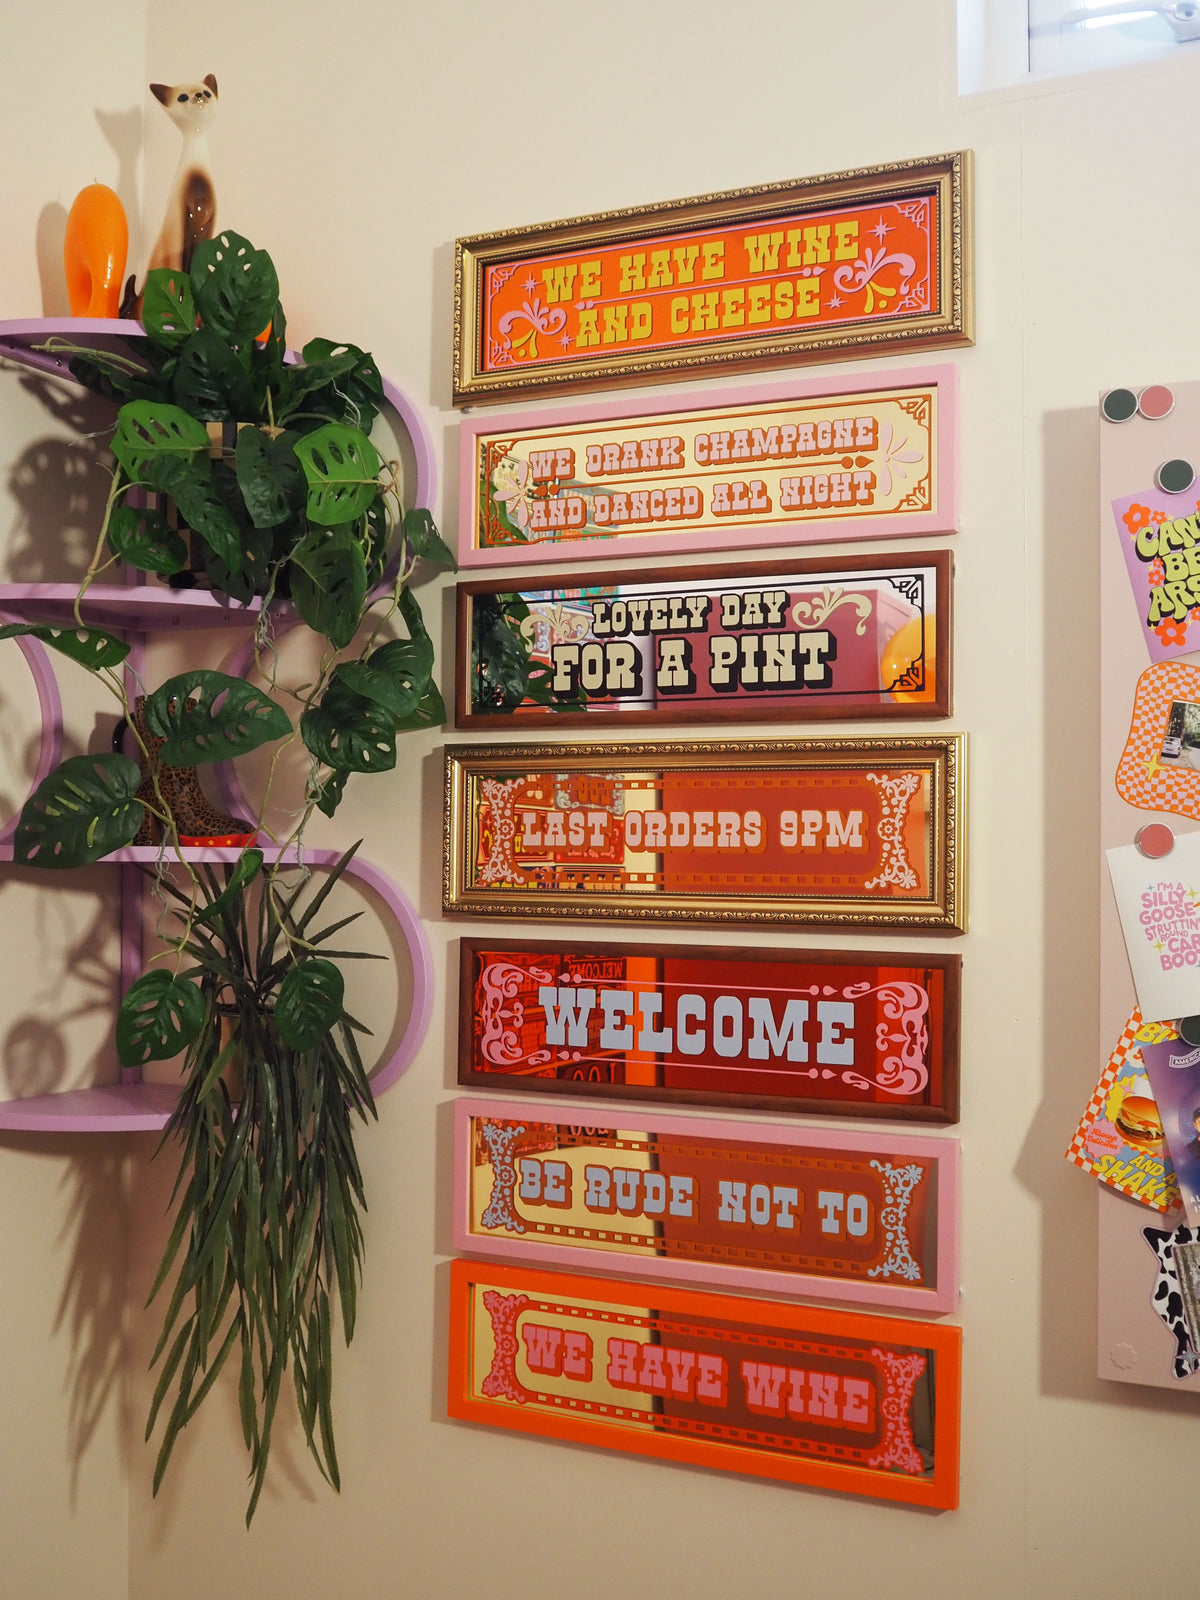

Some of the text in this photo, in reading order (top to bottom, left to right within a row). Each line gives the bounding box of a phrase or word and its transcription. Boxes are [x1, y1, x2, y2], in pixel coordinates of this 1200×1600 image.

[541, 220, 860, 304] WE HAVE WINE
[576, 277, 821, 348] AND CHEESE
[529, 416, 878, 483] WE DRANK CHAMPAGNE
[530, 470, 877, 531] AND DANCED ALL NIGHT
[592, 589, 788, 637] LOVELY DAY
[551, 630, 836, 696] FOR A PINT
[522, 808, 866, 851] LAST ORDERS 9PM
[1141, 890, 1187, 909] SILLY
[1157, 882, 1184, 891] I'M A
[1139, 902, 1196, 925] GOOSE
[1160, 930, 1188, 942] ROUND
[1160, 949, 1200, 971] BOO
[538, 986, 855, 1066] WELCOME
[1174, 1050, 1200, 1065] AMERIC
[1092, 1154, 1180, 1207] SHAKE
[1129, 1154, 1165, 1176] AND
[519, 1159, 871, 1238] BE RUDE NOT TO
[522, 1323, 874, 1428] WE HAVE WINE
